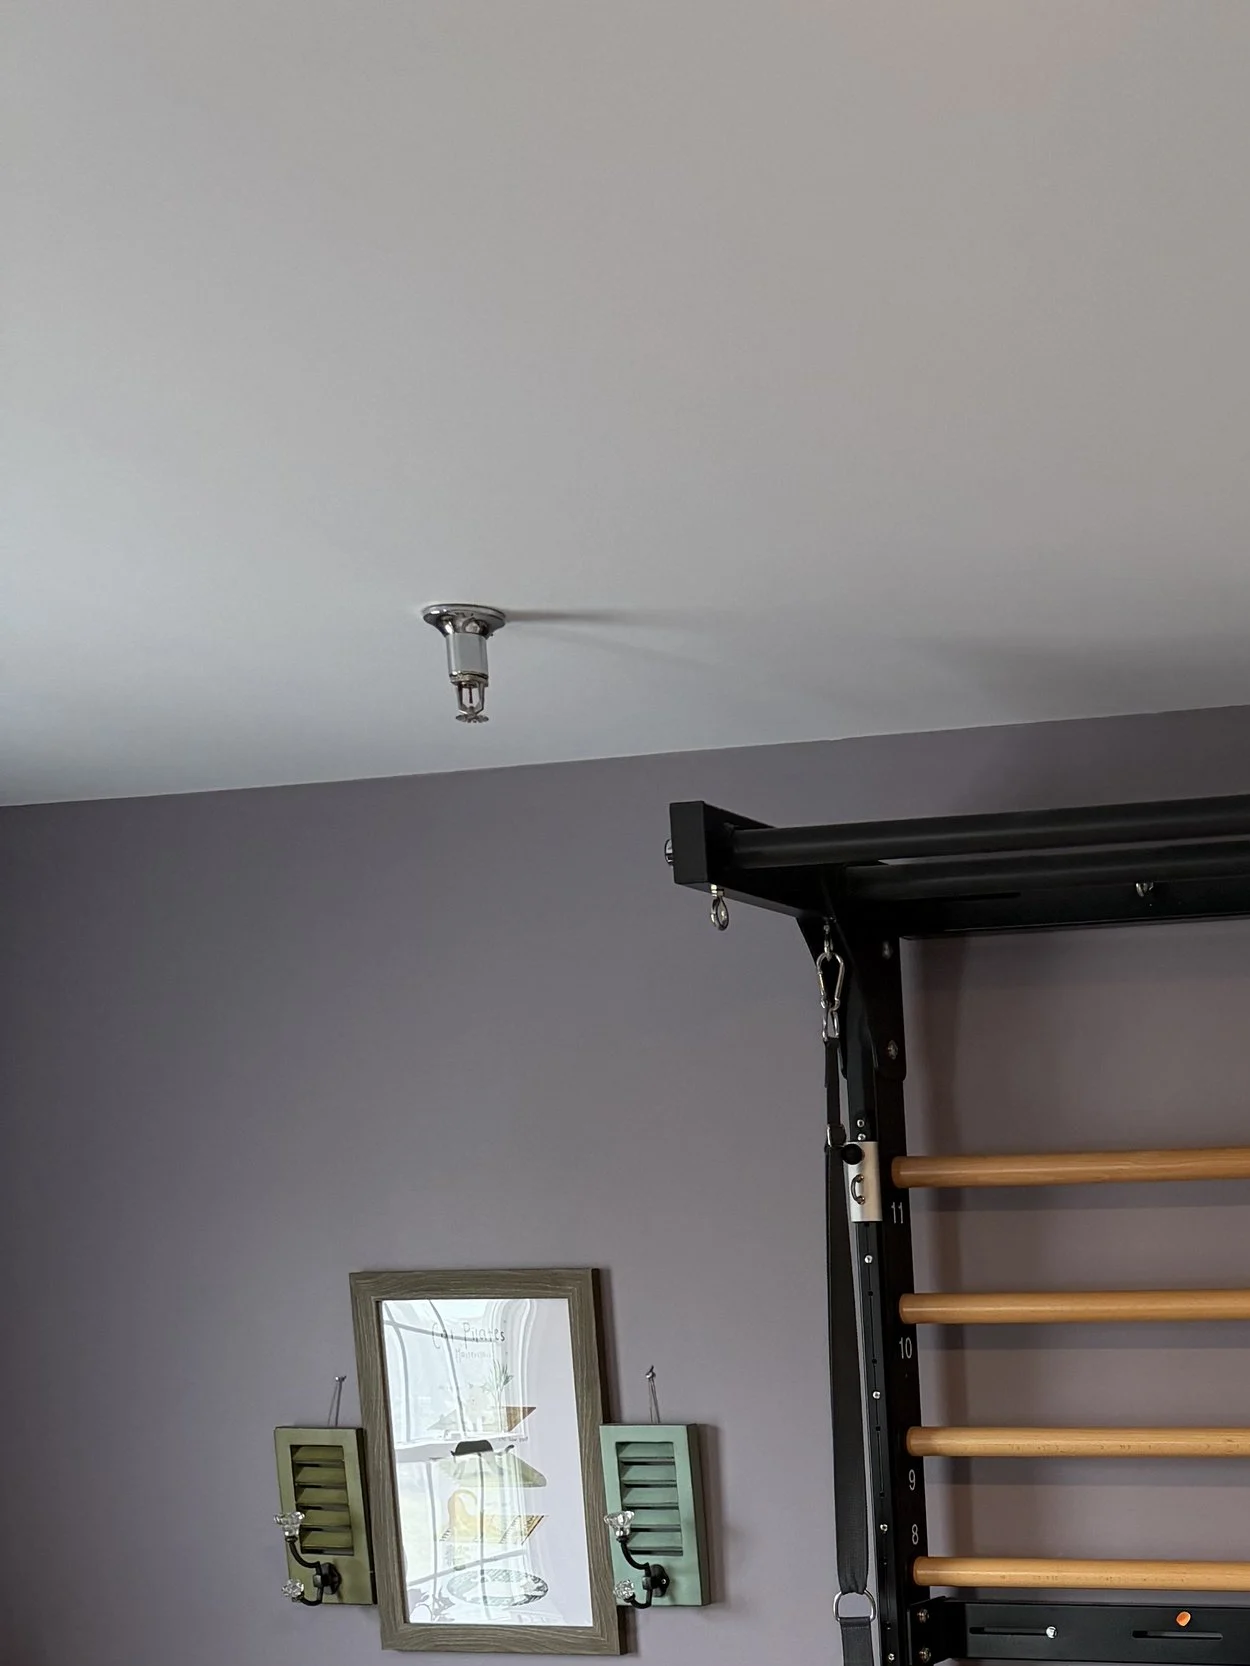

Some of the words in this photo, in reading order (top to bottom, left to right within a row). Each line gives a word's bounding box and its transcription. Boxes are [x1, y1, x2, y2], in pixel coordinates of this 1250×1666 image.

[890, 1201, 905, 1224] 11
[463, 1321, 506, 1350] Pilates
[898, 1336, 913, 1360] 10
[908, 1468, 916, 1491] 9
[911, 1523, 919, 1545] 8
